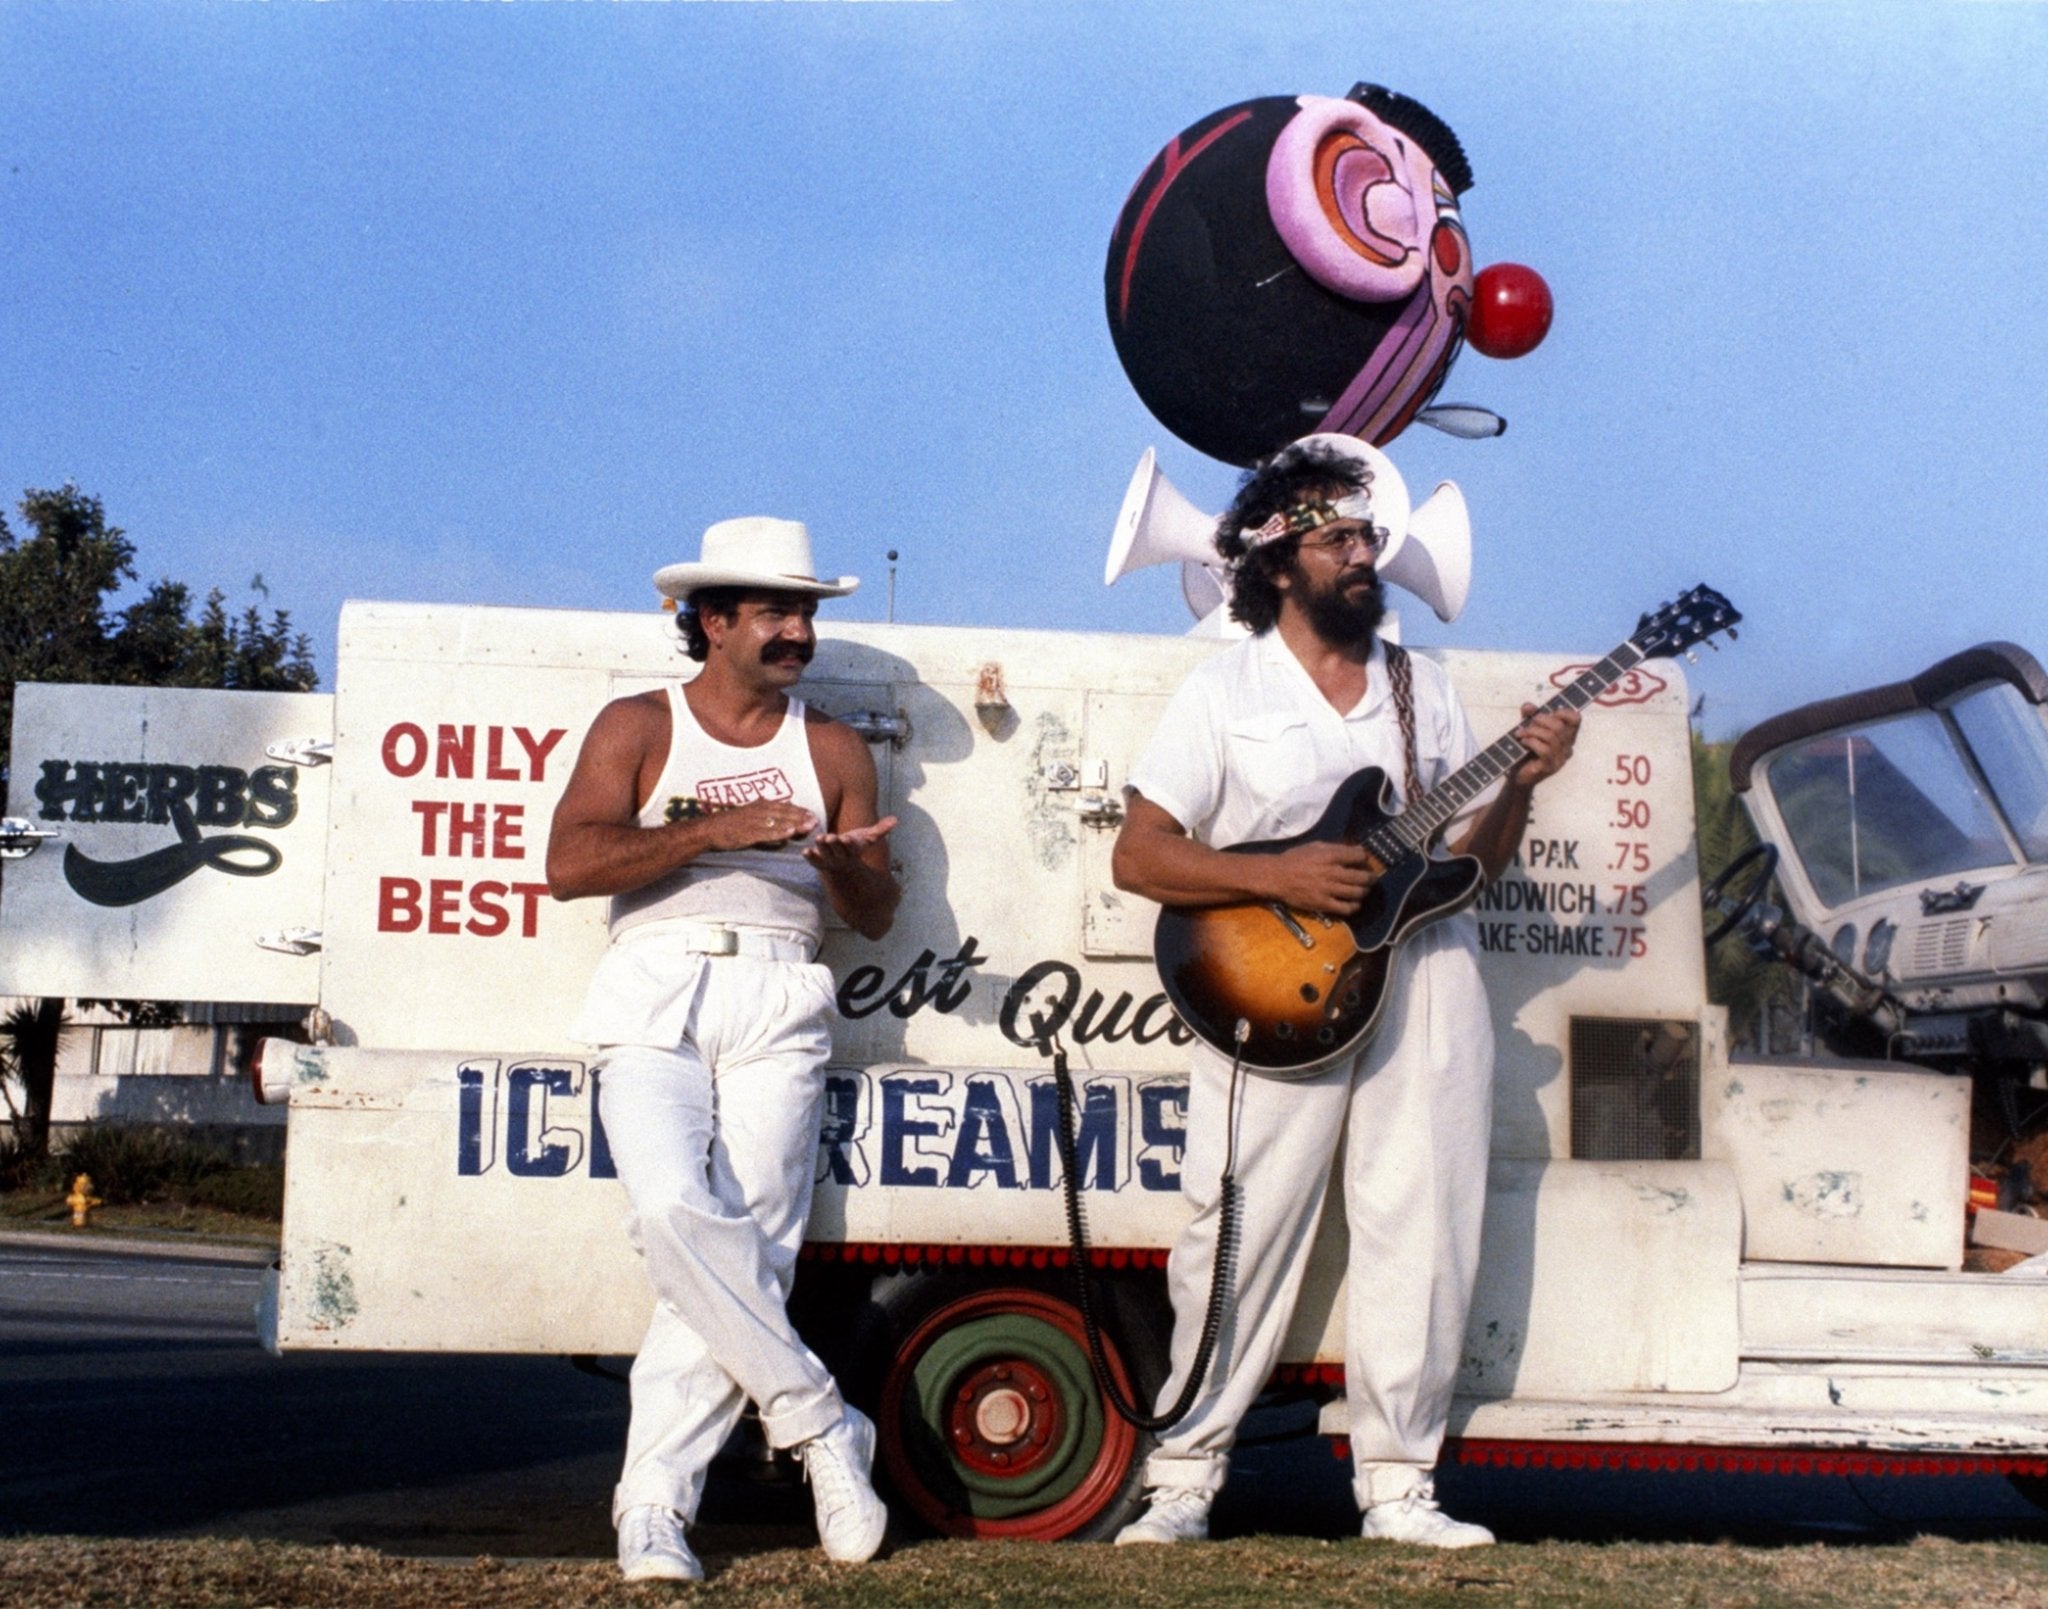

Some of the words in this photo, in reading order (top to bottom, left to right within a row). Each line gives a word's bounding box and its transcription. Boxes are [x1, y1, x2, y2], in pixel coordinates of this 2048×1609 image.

[381, 721, 569, 782] ONLY
[1606, 754, 1651, 786] .50
[701, 774, 782, 806] HAPPY
[411, 800, 526, 859] THE
[1609, 799, 1651, 829] .50
[1529, 839, 1580, 869] PAK
[1607, 842, 1650, 872] .75
[377, 876, 551, 938] BEST
[1476, 881, 1596, 914] NDWICH
[1605, 885, 1649, 916] .75
[1478, 922, 1603, 956] AKE-SHAKE
[1608, 926, 1647, 958] .75
[837, 936, 988, 1019] est
[1000, 960, 1197, 1058] Qua
[817, 1067, 1191, 1192] REAMS
